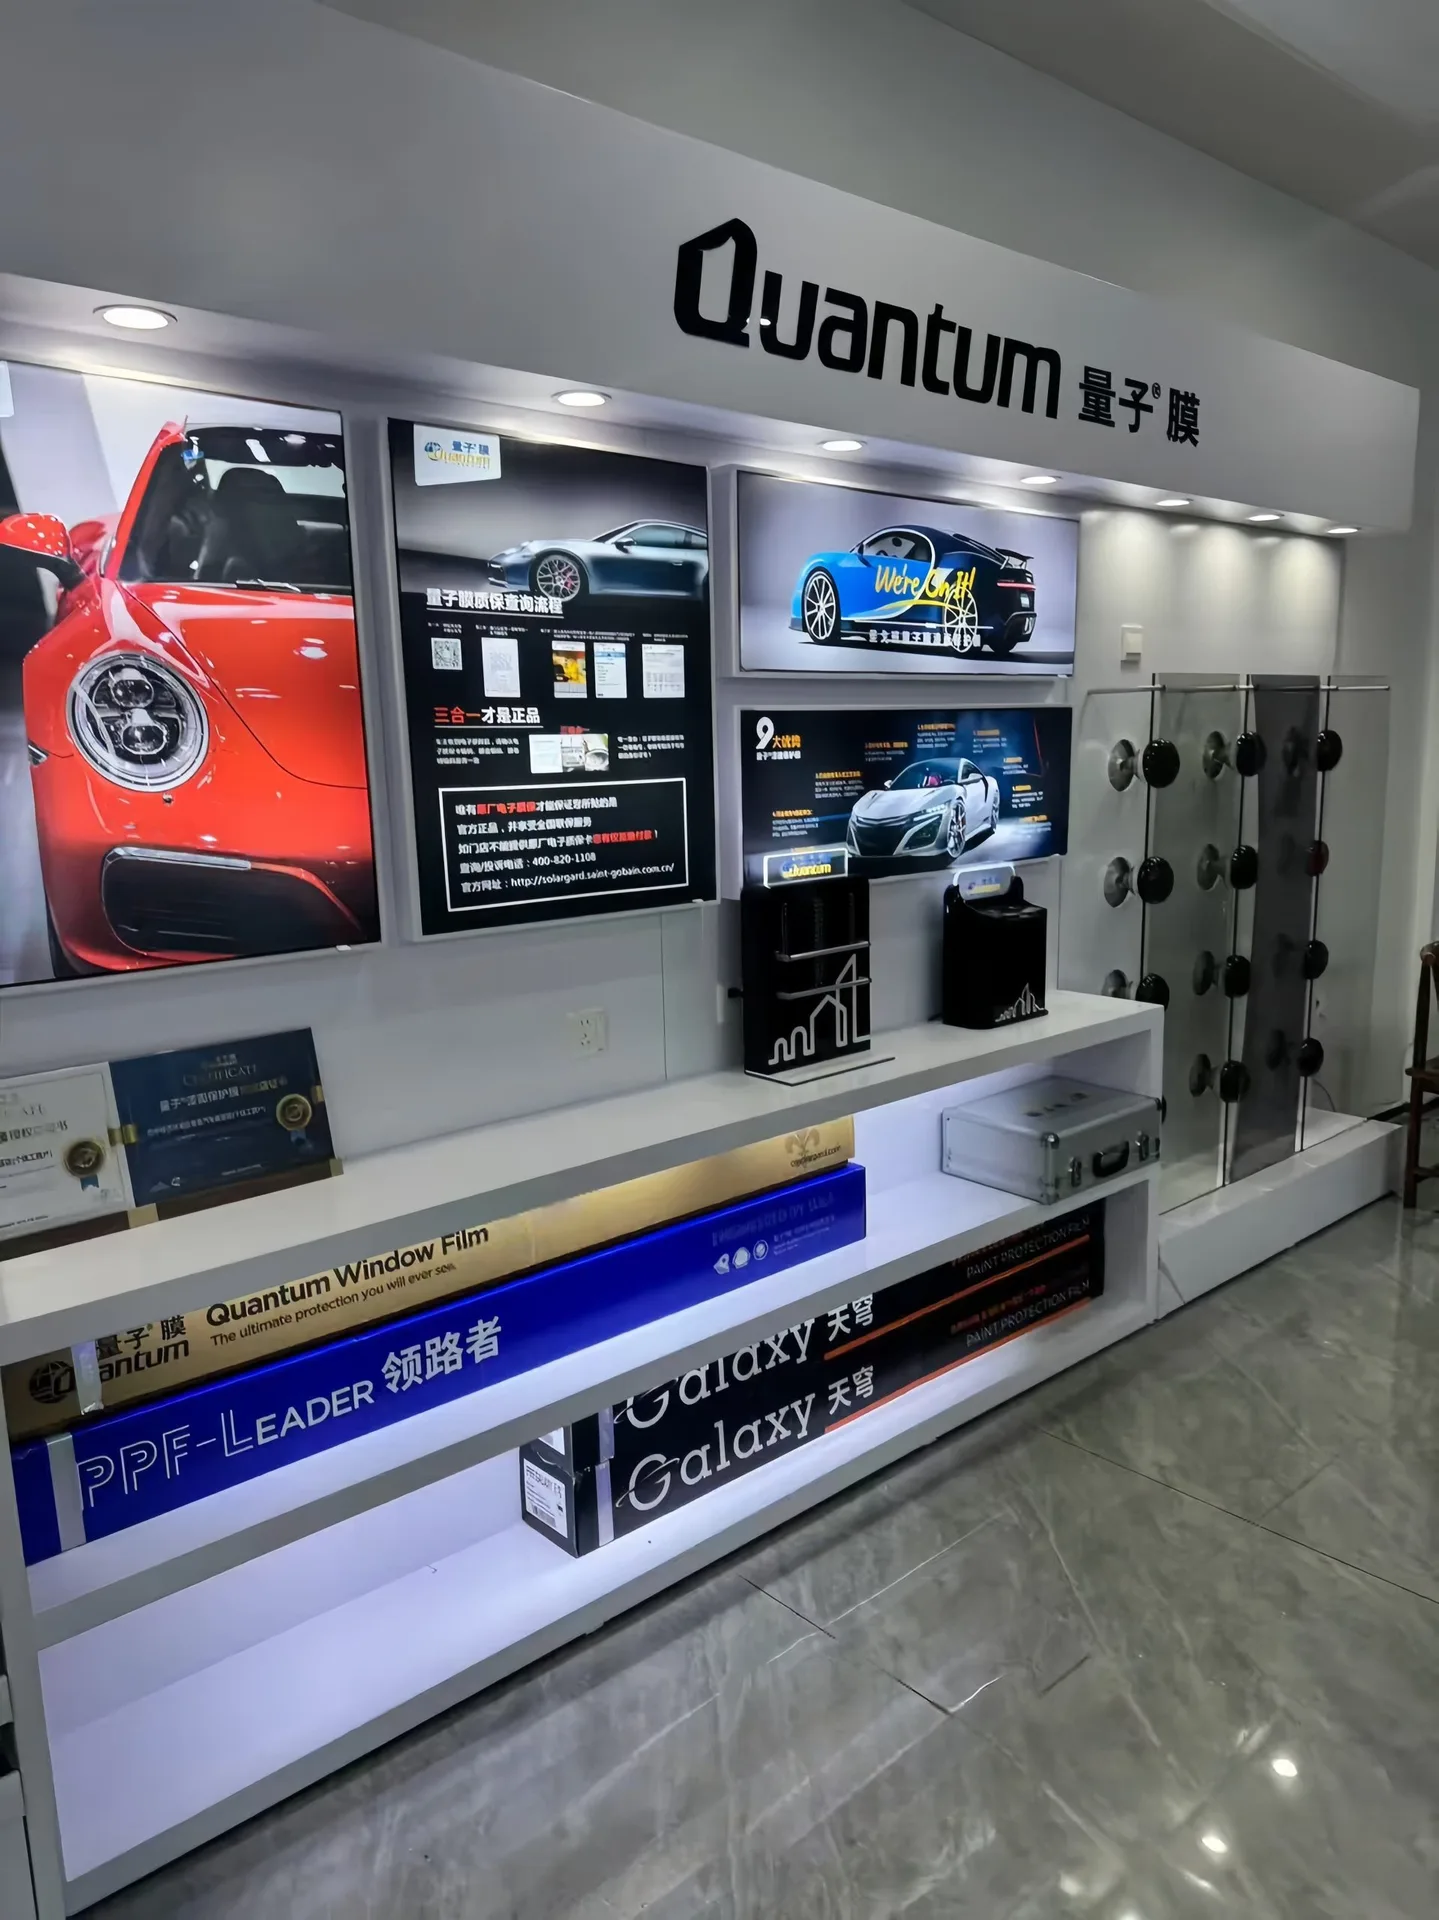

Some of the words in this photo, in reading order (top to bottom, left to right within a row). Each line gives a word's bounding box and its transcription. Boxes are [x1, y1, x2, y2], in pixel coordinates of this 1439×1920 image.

[674, 218, 1061, 419] Quantum
[434, 706, 541, 724] 三合一才是正品
[206, 1275, 331, 1327] Quantum
[332, 1244, 434, 1288] Window
[441, 1226, 489, 1256] Film
[210, 1331, 236, 1347] The
[240, 1314, 293, 1339] ultimate
[295, 1293, 359, 1324] protection
[361, 1284, 385, 1302] you
[387, 1275, 406, 1292] will
[408, 1267, 433, 1285] ever
[381, 1315, 502, 1393] 领路者
[614, 1318, 815, 1428] Galaxy
[827, 1293, 873, 1342] 天穹
[615, 1393, 816, 1511] Galaxy
[828, 1364, 874, 1415] 天穹
